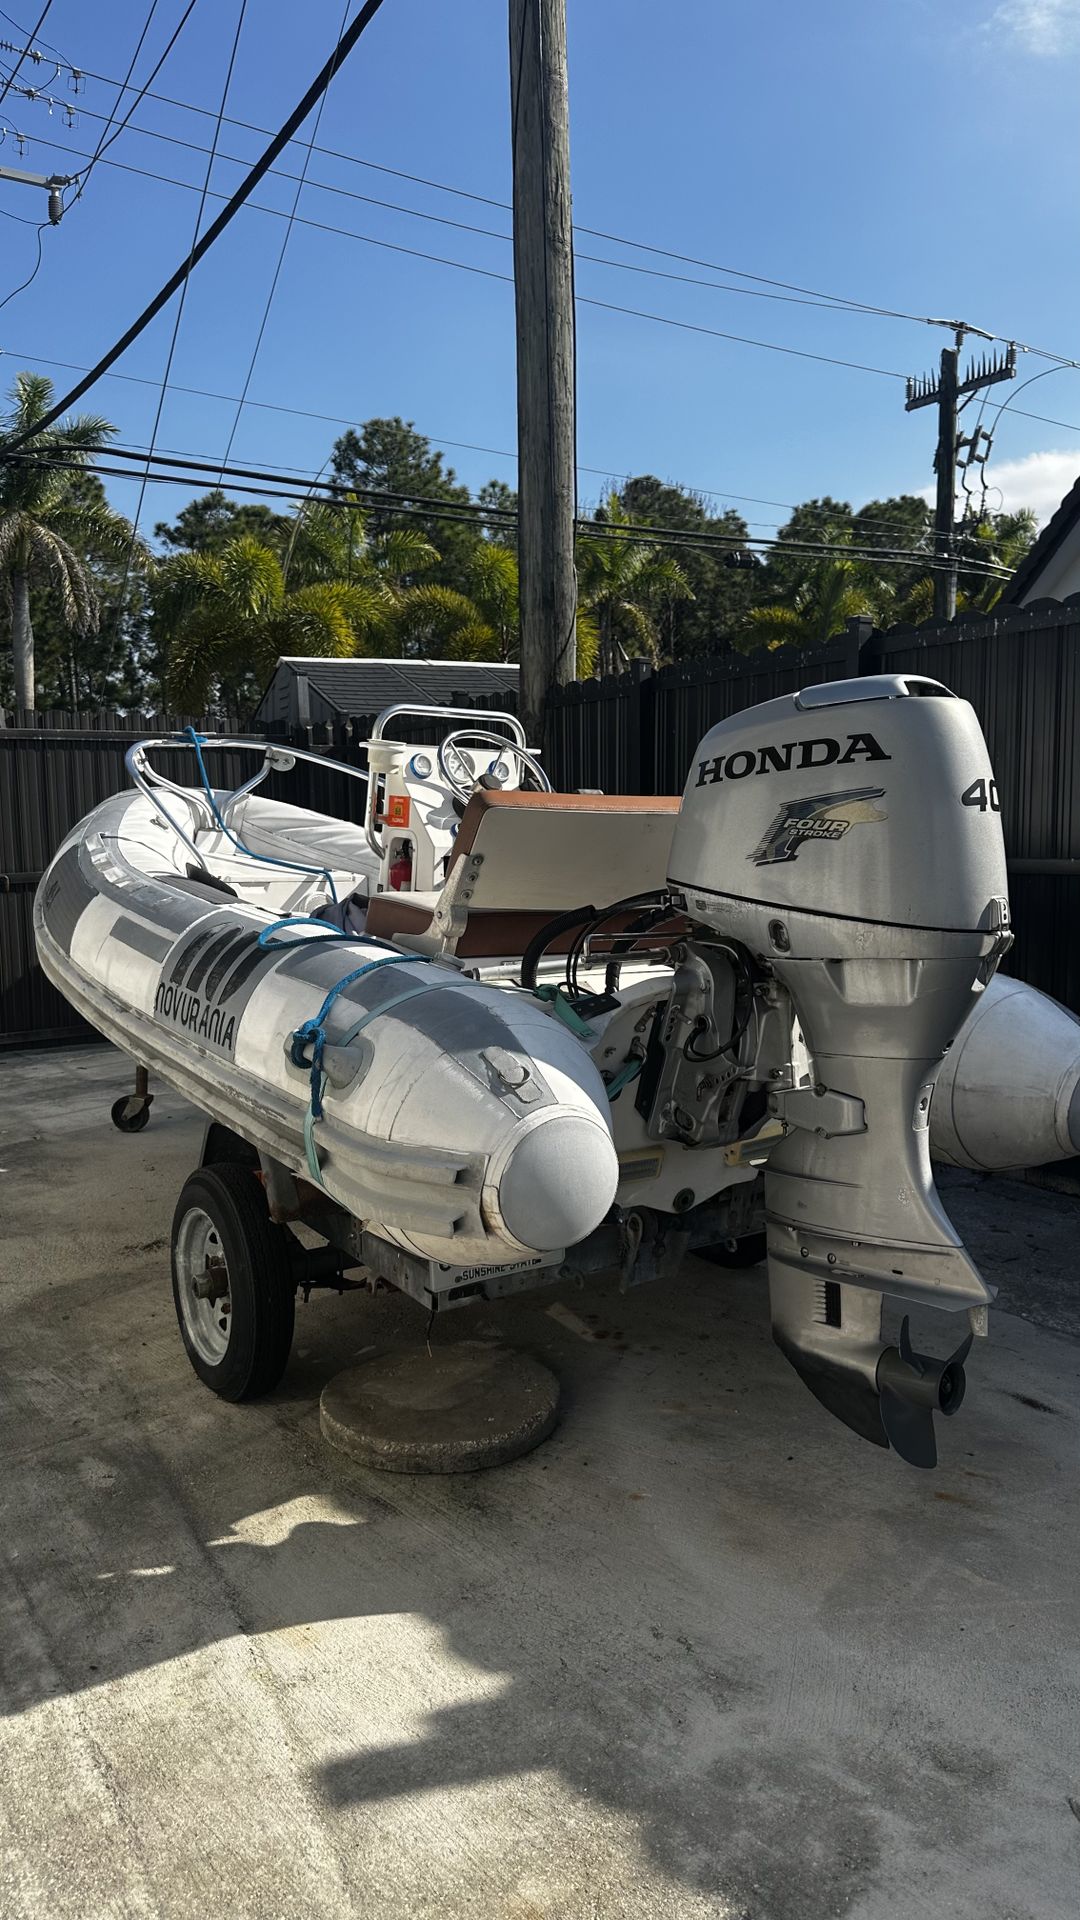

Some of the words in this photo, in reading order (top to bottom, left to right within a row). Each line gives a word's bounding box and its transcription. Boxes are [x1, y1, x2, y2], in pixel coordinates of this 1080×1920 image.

[695, 733, 891, 787] HONDA
[783, 818, 850, 832] FOUR
[789, 829, 843, 838] STROKE
[462, 1266, 506, 1281] SUNSHINE
